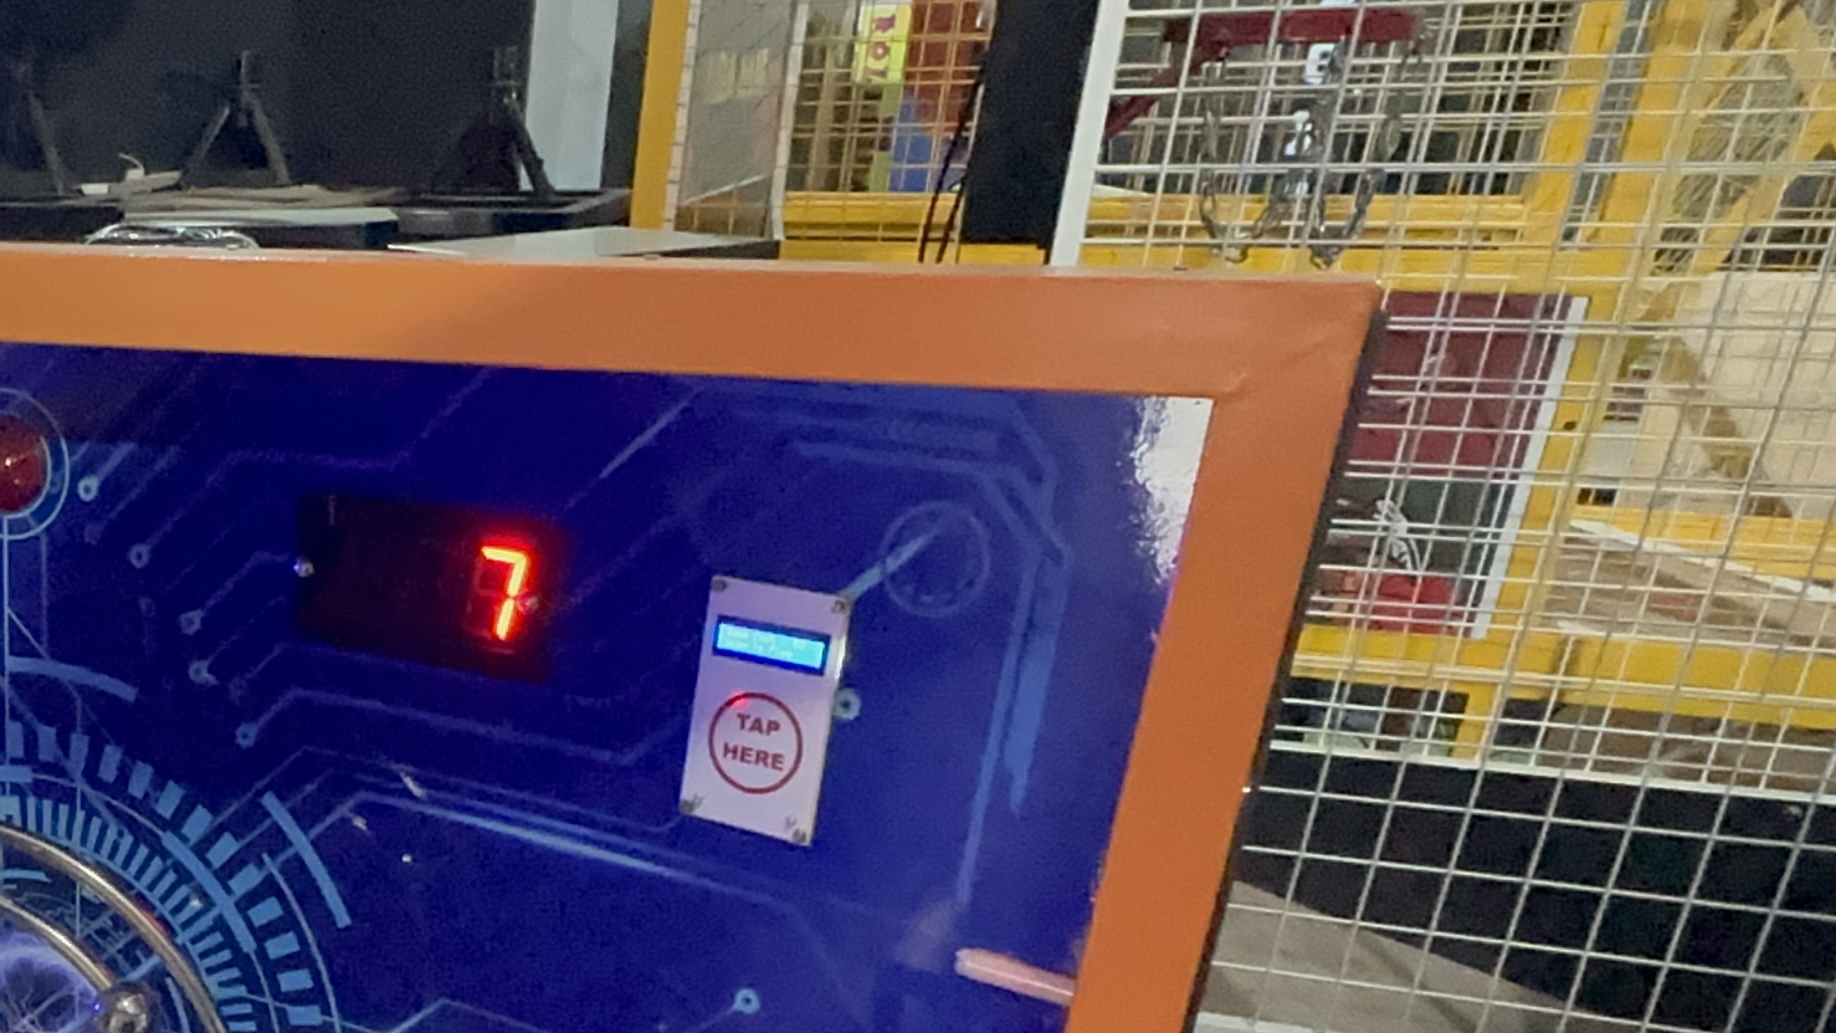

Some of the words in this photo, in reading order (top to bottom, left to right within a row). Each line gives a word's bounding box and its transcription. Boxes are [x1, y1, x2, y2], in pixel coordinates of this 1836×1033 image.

[479, 545, 529, 642] 7
[736, 712, 781, 737] TAP
[722, 742, 785, 772] HERE
